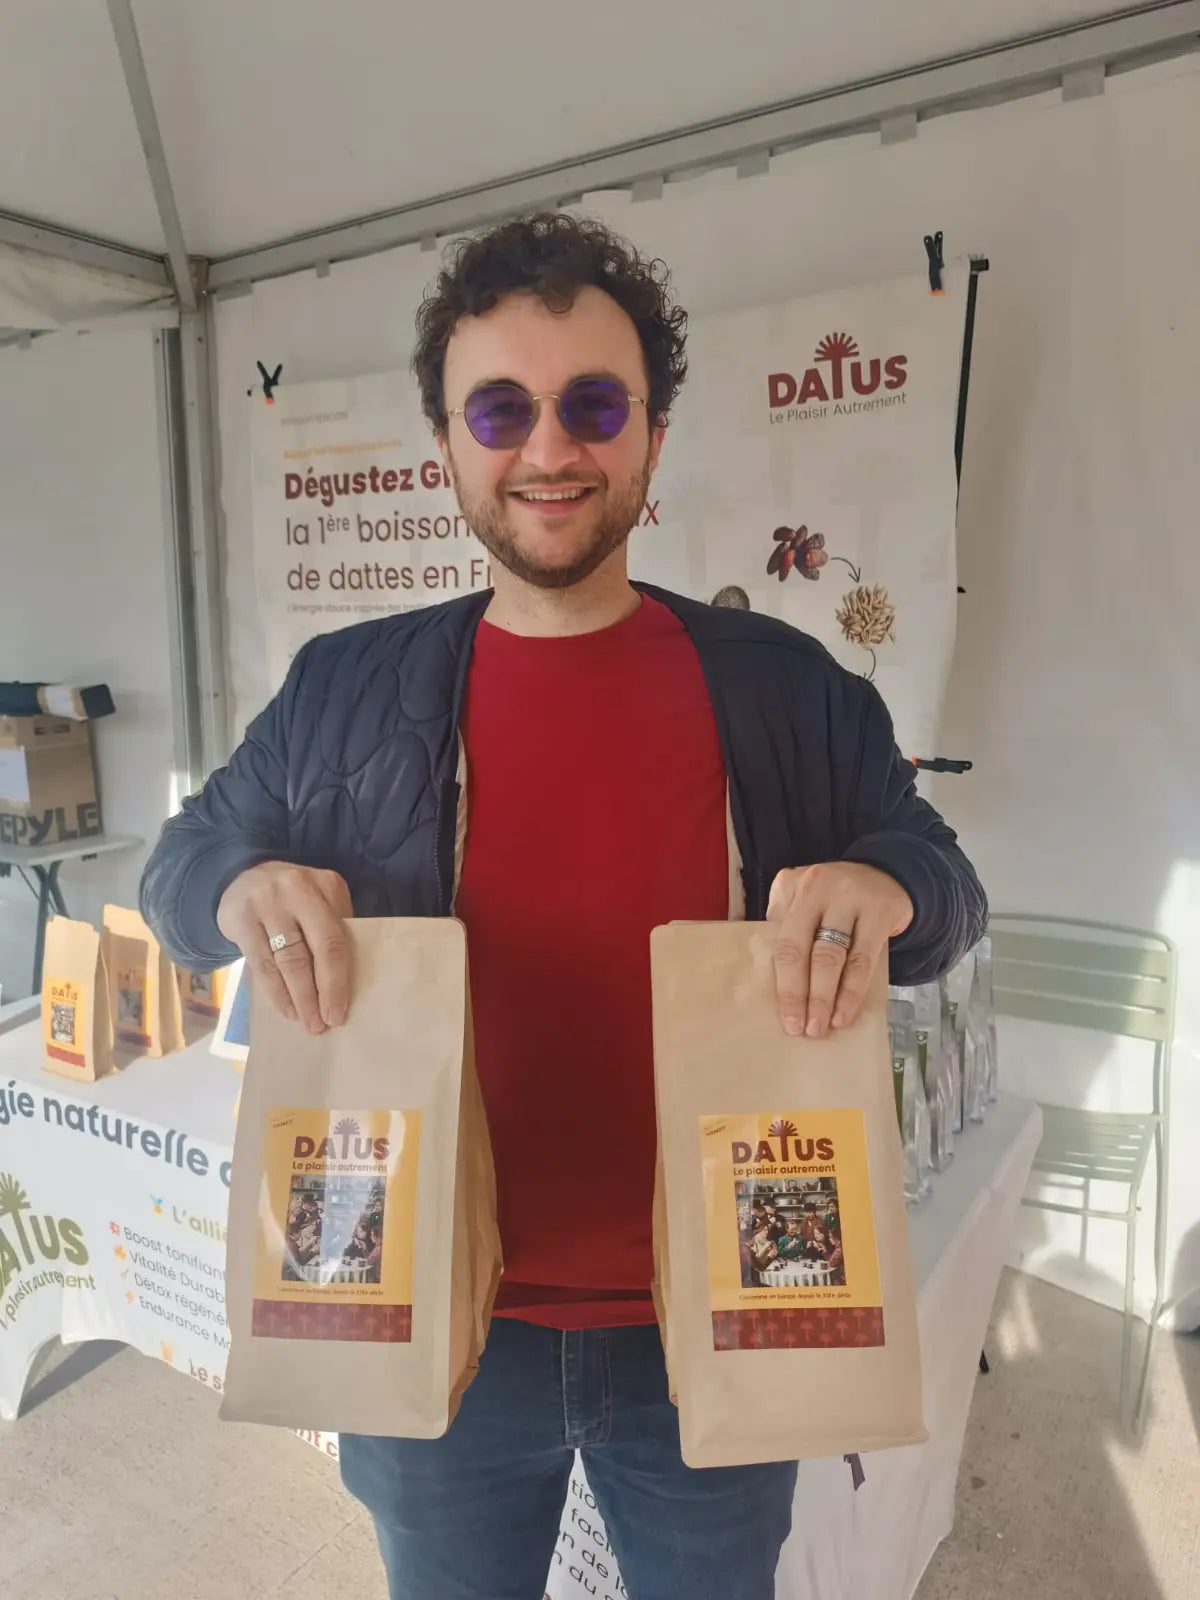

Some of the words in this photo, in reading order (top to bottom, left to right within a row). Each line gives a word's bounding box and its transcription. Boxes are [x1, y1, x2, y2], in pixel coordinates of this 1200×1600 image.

[768, 332, 908, 408] DATUS
[769, 411, 784, 424] Le
[787, 405, 828, 423] Plaisir
[833, 392, 907, 416] Autrement
[285, 465, 414, 507] Dégustez
[286, 518, 310, 545] la
[318, 517, 350, 544] 1ère
[287, 562, 321, 590] de
[329, 561, 414, 590] dattes
[423, 564, 460, 588] en
[43, 1096, 209, 1177] naturelle
[293, 1117, 390, 1161] DATUS
[731, 1119, 835, 1164] DATUS
[305, 1161, 336, 1173] plaisir
[337, 1162, 388, 1173] autrement
[733, 1166, 744, 1177] Le
[746, 1164, 778, 1178] plaisir
[780, 1163, 836, 1175] autrement
[124, 1226, 163, 1255] Boost
[128, 1250, 177, 1281] Vitalité
[139, 1295, 210, 1340] Endurance
